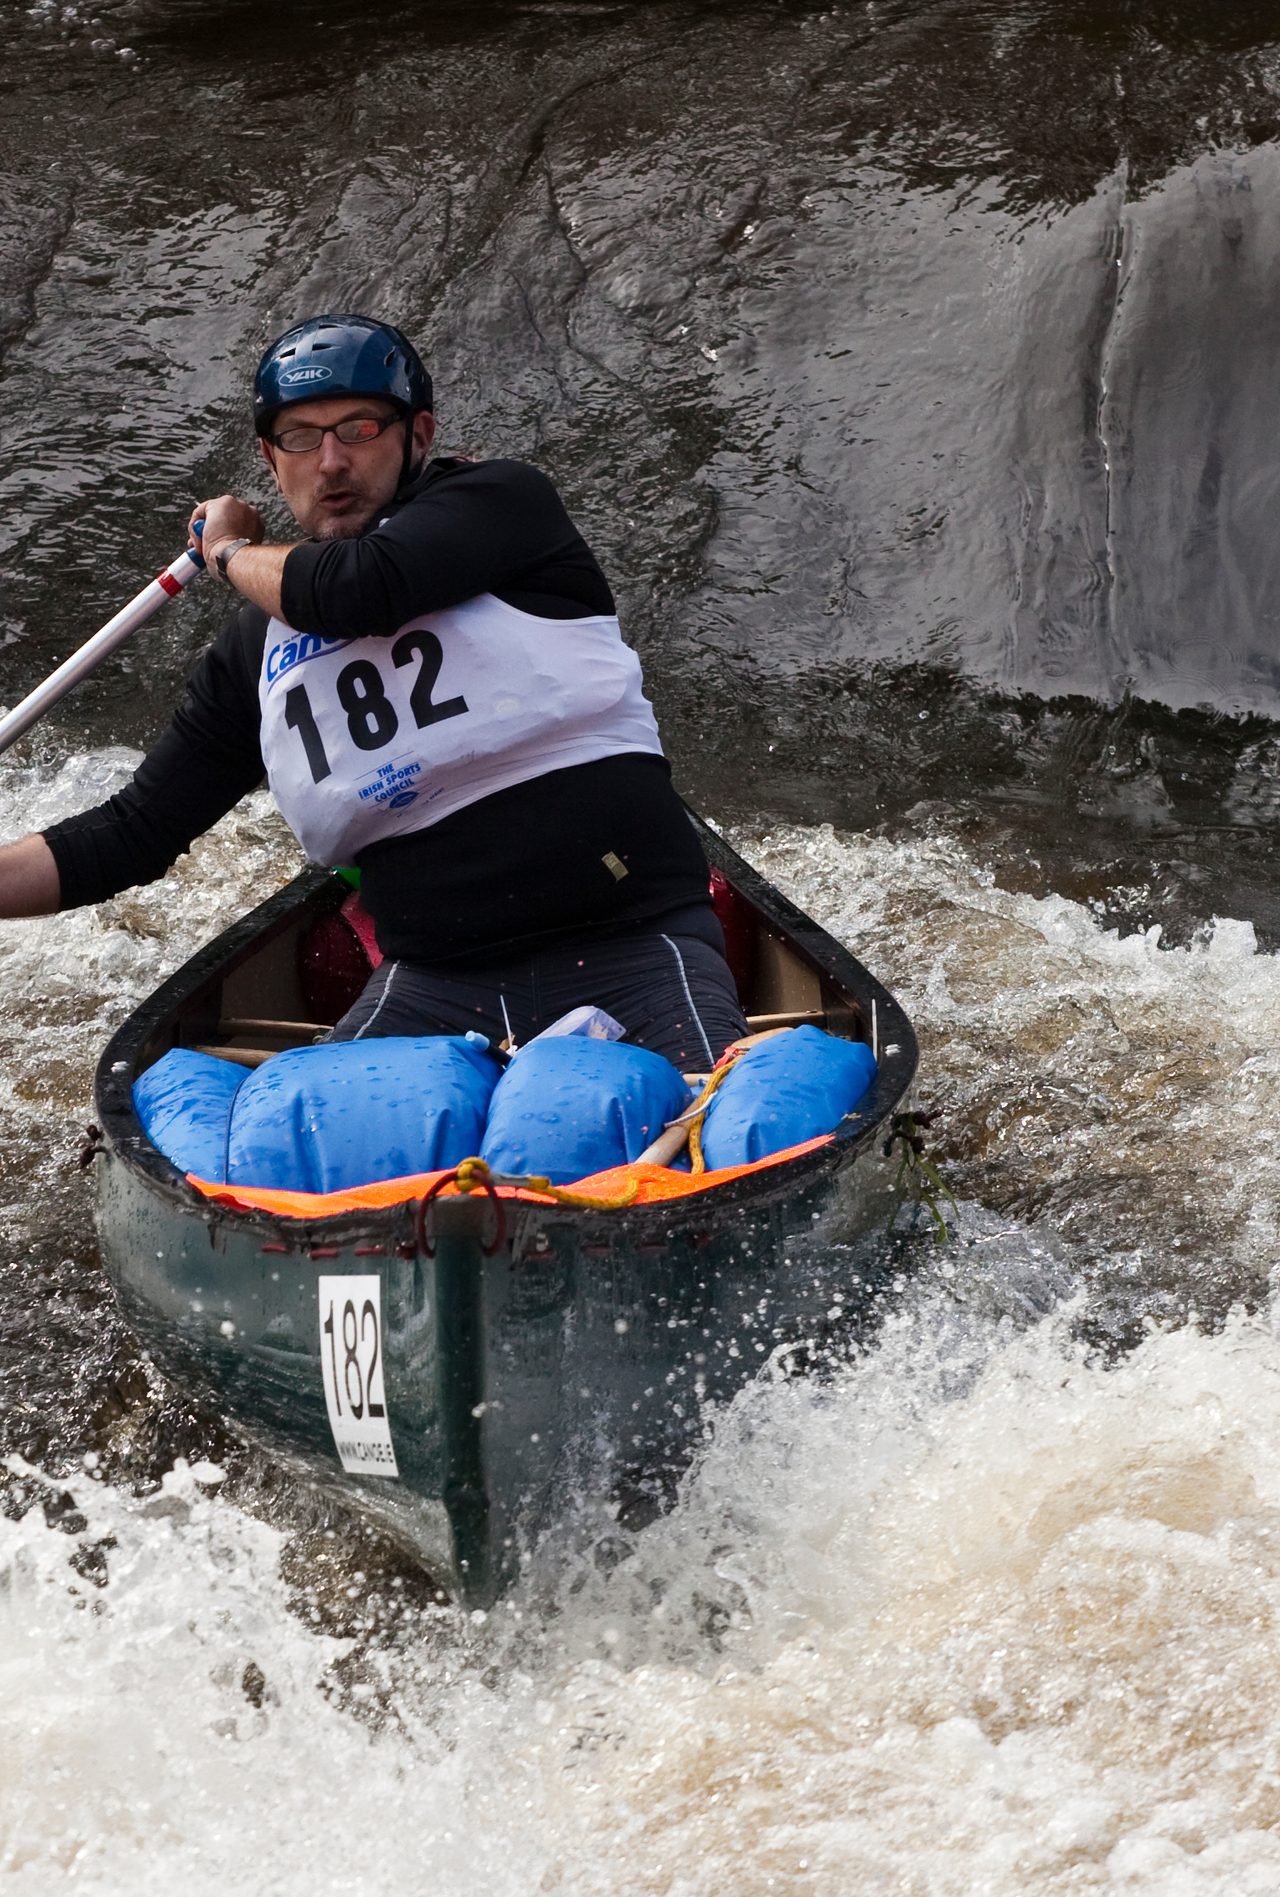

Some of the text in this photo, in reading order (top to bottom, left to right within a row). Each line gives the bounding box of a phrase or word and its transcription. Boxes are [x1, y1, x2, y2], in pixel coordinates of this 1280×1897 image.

[287, 369, 324, 383] YAK
[285, 630, 469, 784] 182
[358, 763, 421, 799] IRISH SPORTS
[377, 764, 395, 778] THE
[375, 778, 415, 802] COUNCIL
[324, 1299, 385, 1420] 182
